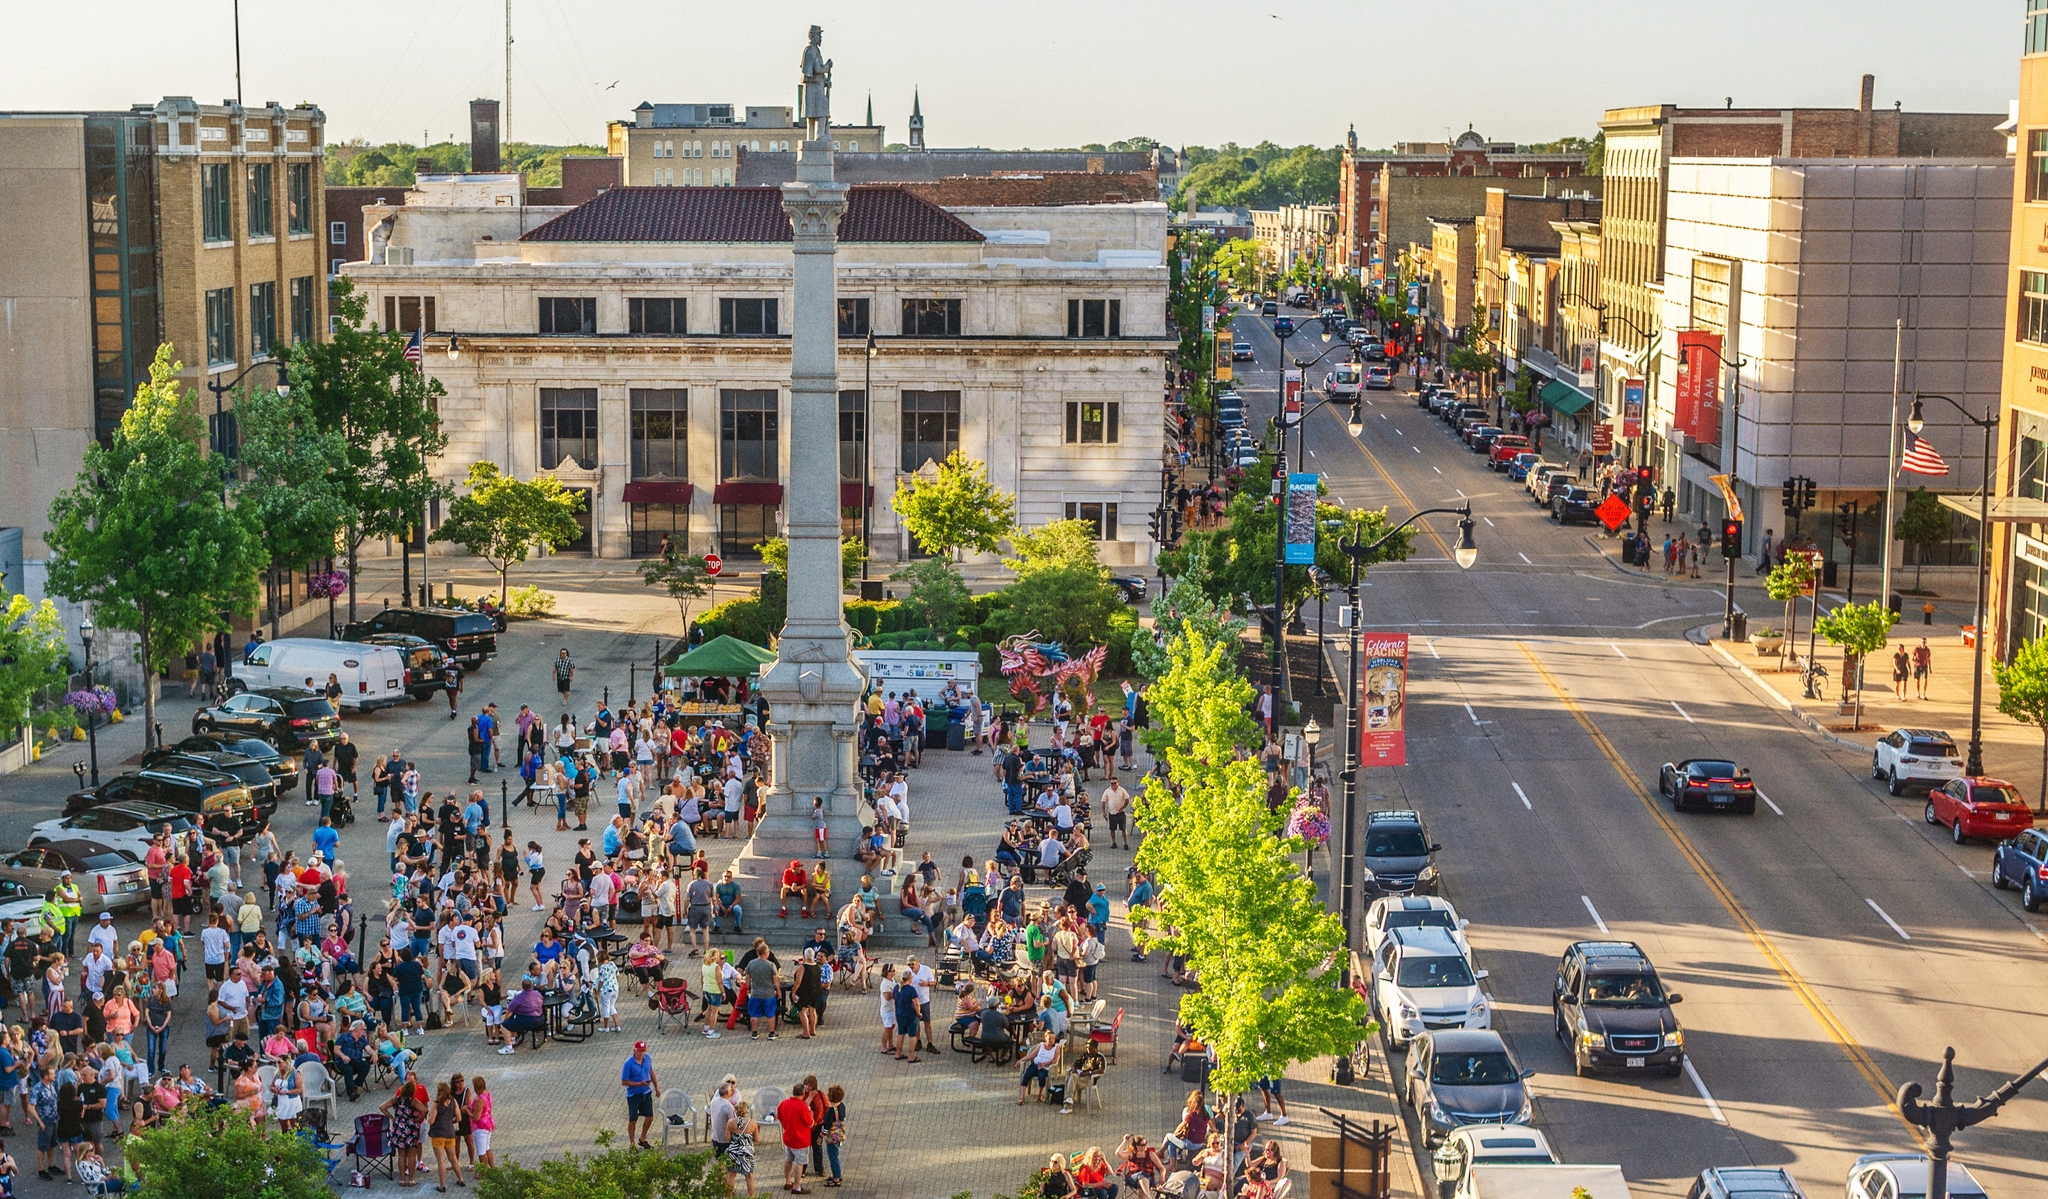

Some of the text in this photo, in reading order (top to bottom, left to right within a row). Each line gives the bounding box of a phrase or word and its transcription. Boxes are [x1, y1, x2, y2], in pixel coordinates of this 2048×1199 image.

[1704, 377, 1714, 408] RAM
[1366, 640, 1406, 650] Celebrate
[1366, 648, 1405, 657] RACINE
[907, 668, 915, 677] $5
